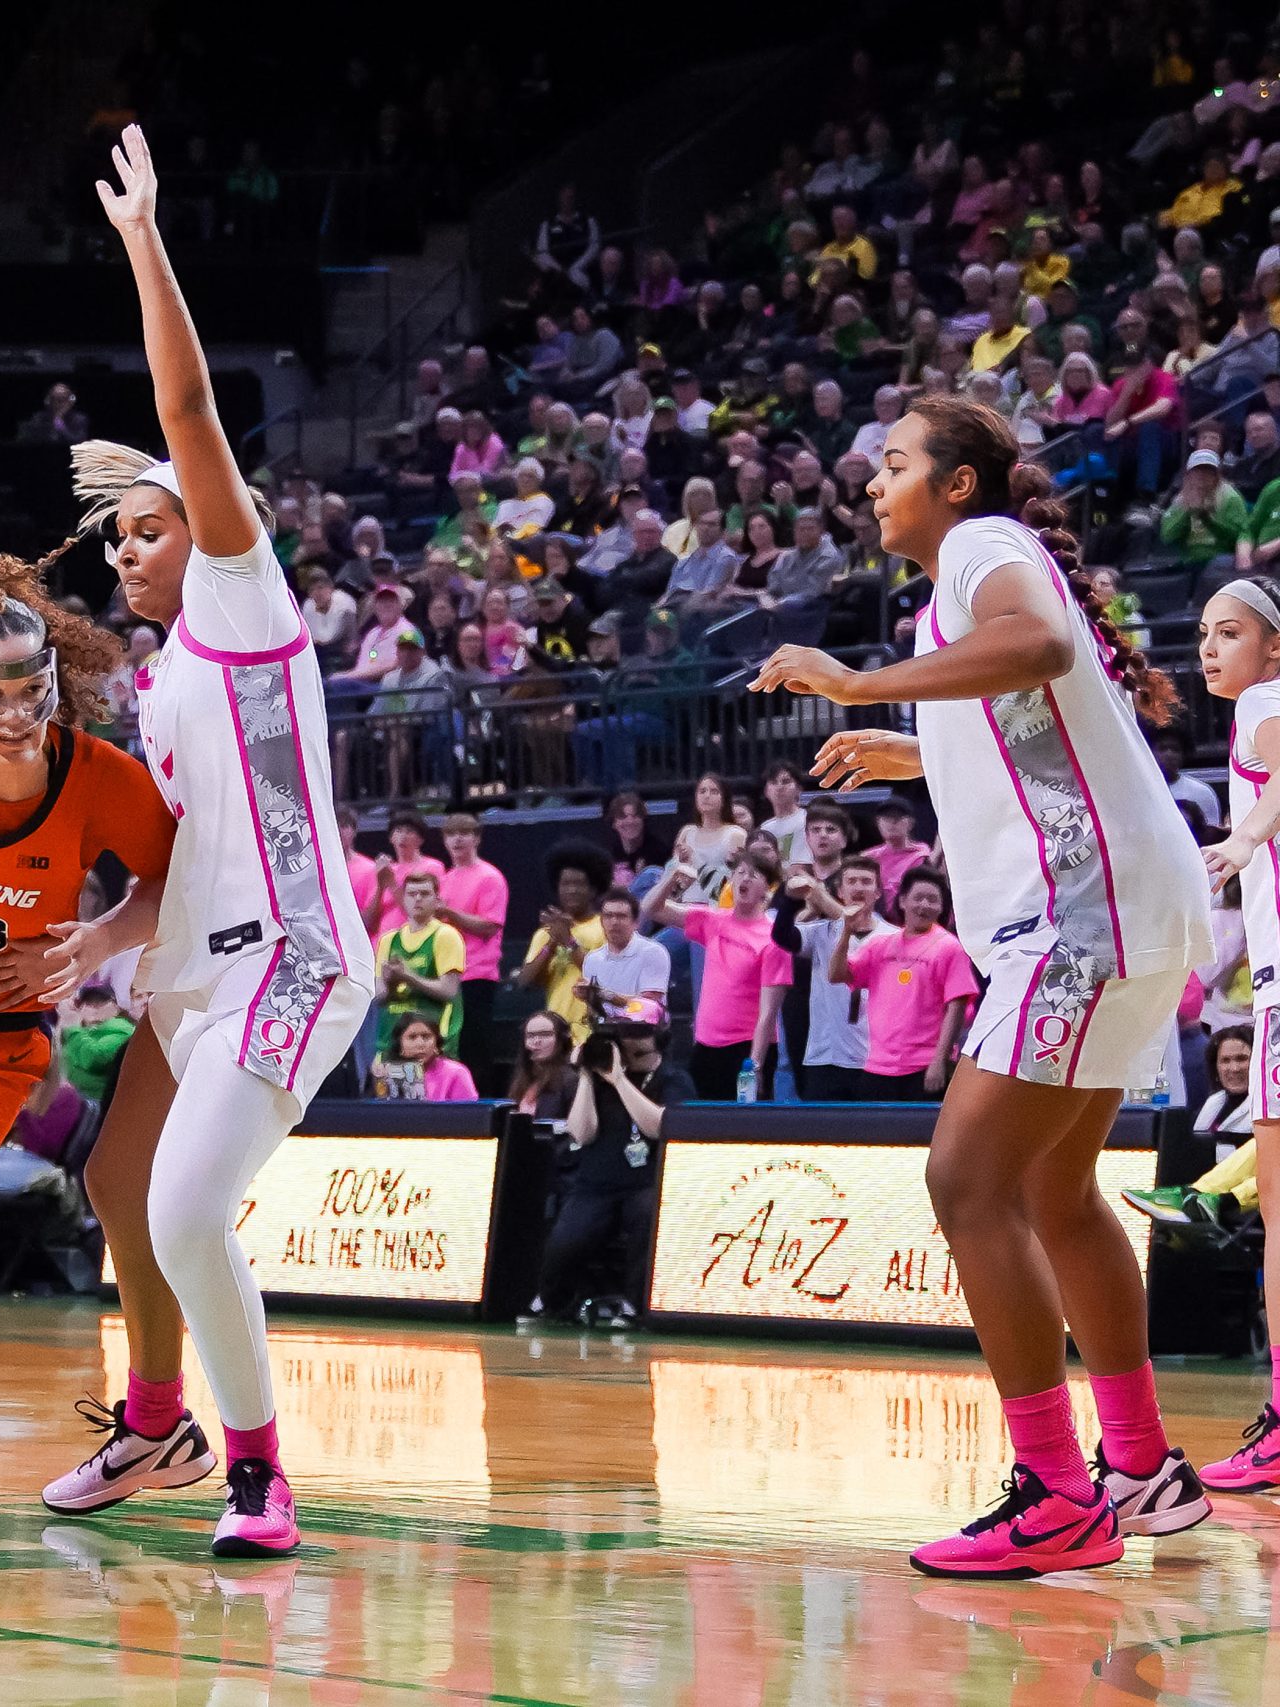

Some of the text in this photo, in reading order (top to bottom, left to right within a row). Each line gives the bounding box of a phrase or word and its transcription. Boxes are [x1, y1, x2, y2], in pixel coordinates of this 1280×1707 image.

[320, 1168, 406, 1218] 100%
[281, 1227, 447, 1271] ALL THE THINGS
[884, 1248, 929, 1292] ALL
